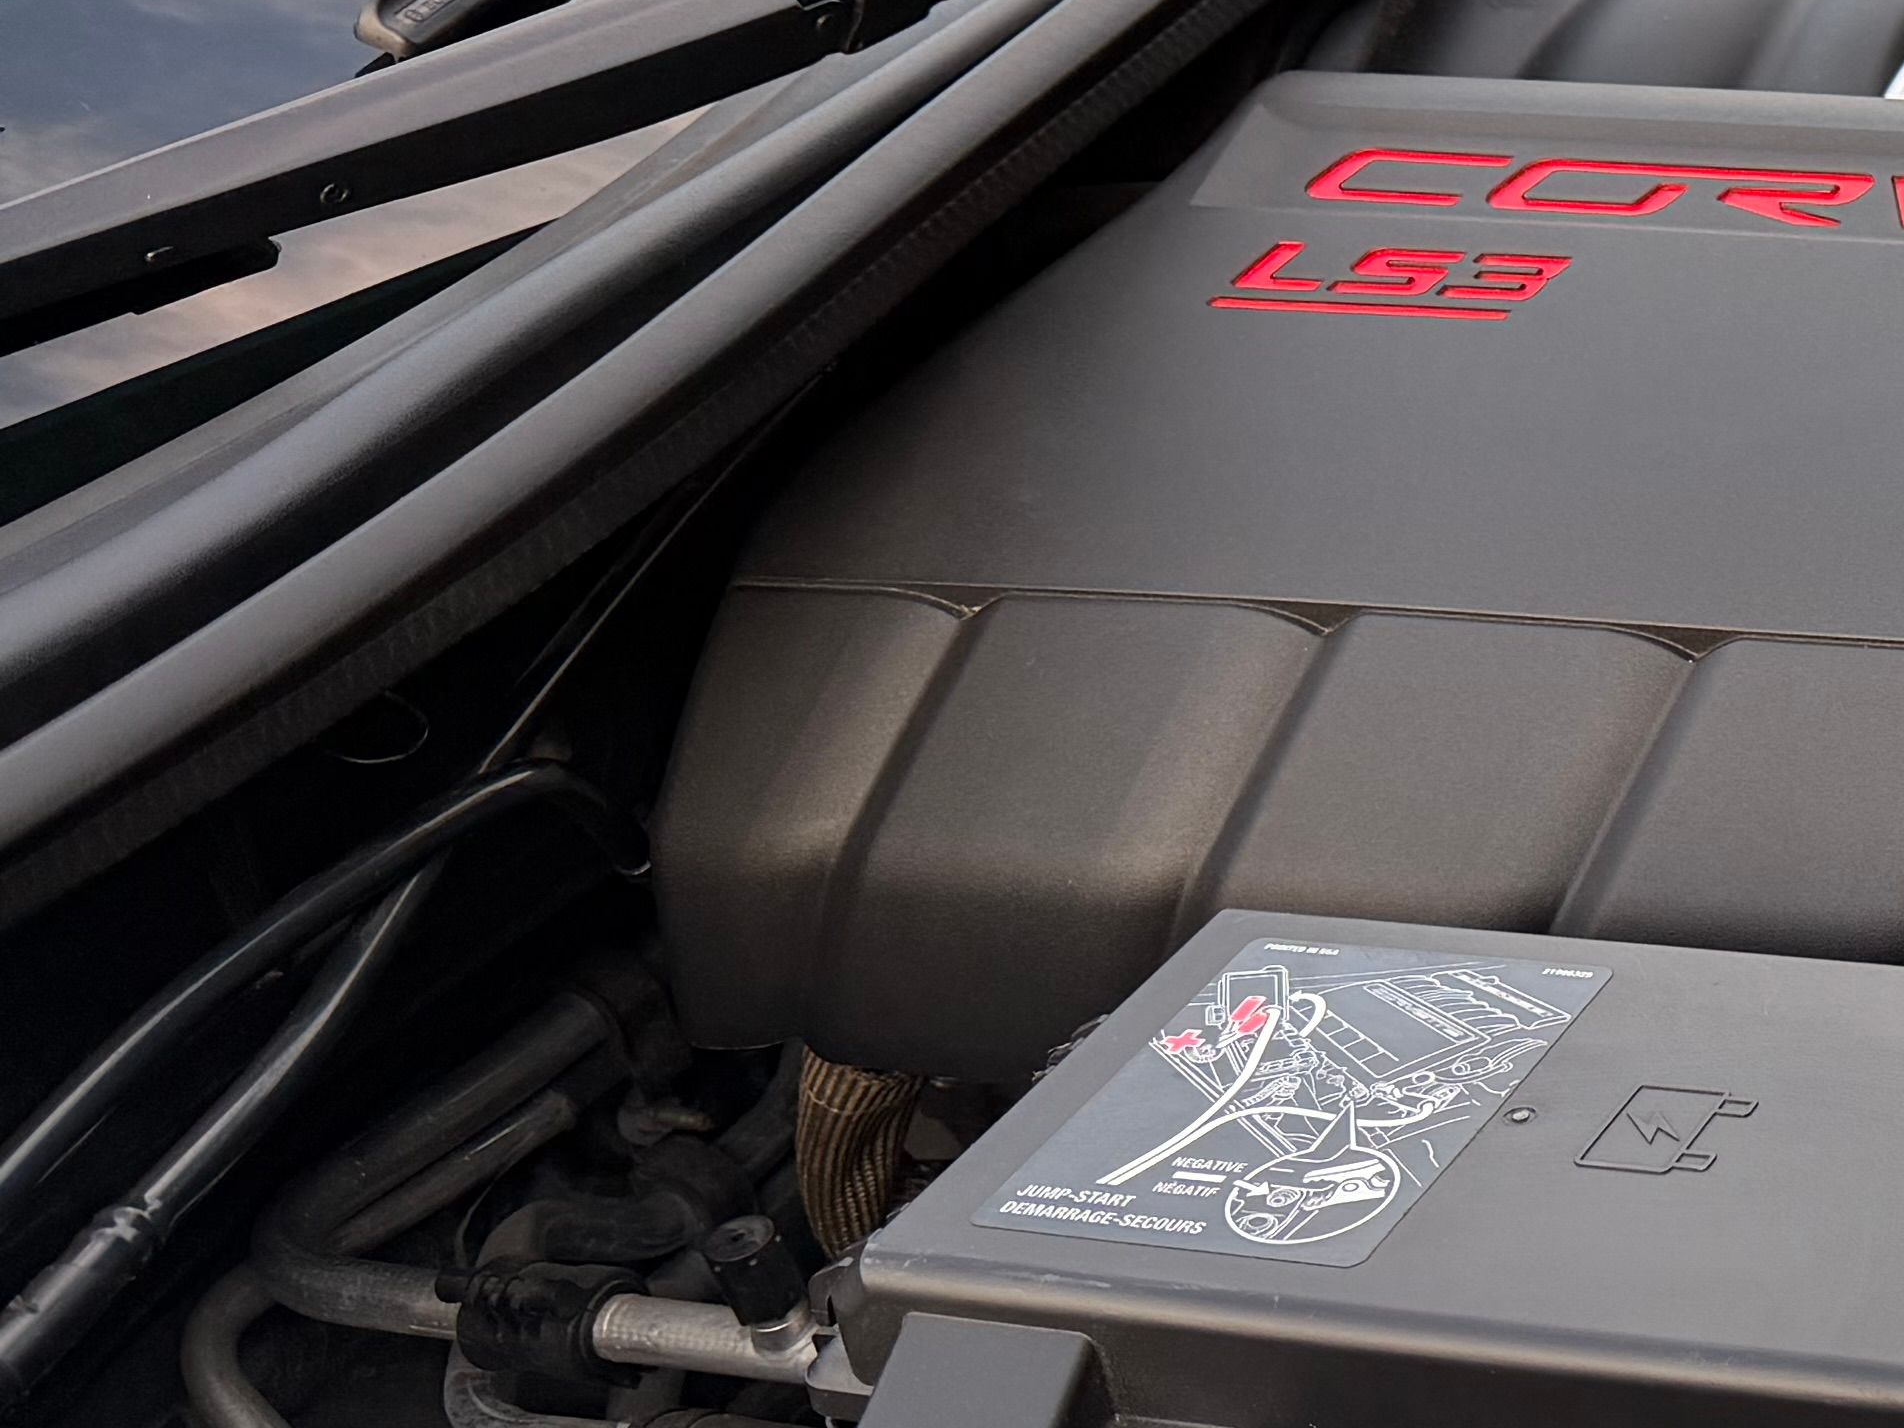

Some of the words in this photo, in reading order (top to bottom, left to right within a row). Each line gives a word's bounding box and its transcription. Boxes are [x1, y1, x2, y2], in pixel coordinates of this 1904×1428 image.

[1230, 239, 1573, 303] LS3
[1172, 1156, 1248, 1173] NEGATIVE
[1016, 1184, 1137, 1208] JUMP-START
[1152, 1180, 1221, 1197] NÉGATIF
[999, 1200, 1207, 1235] DEMARRAGE-SECOURS
